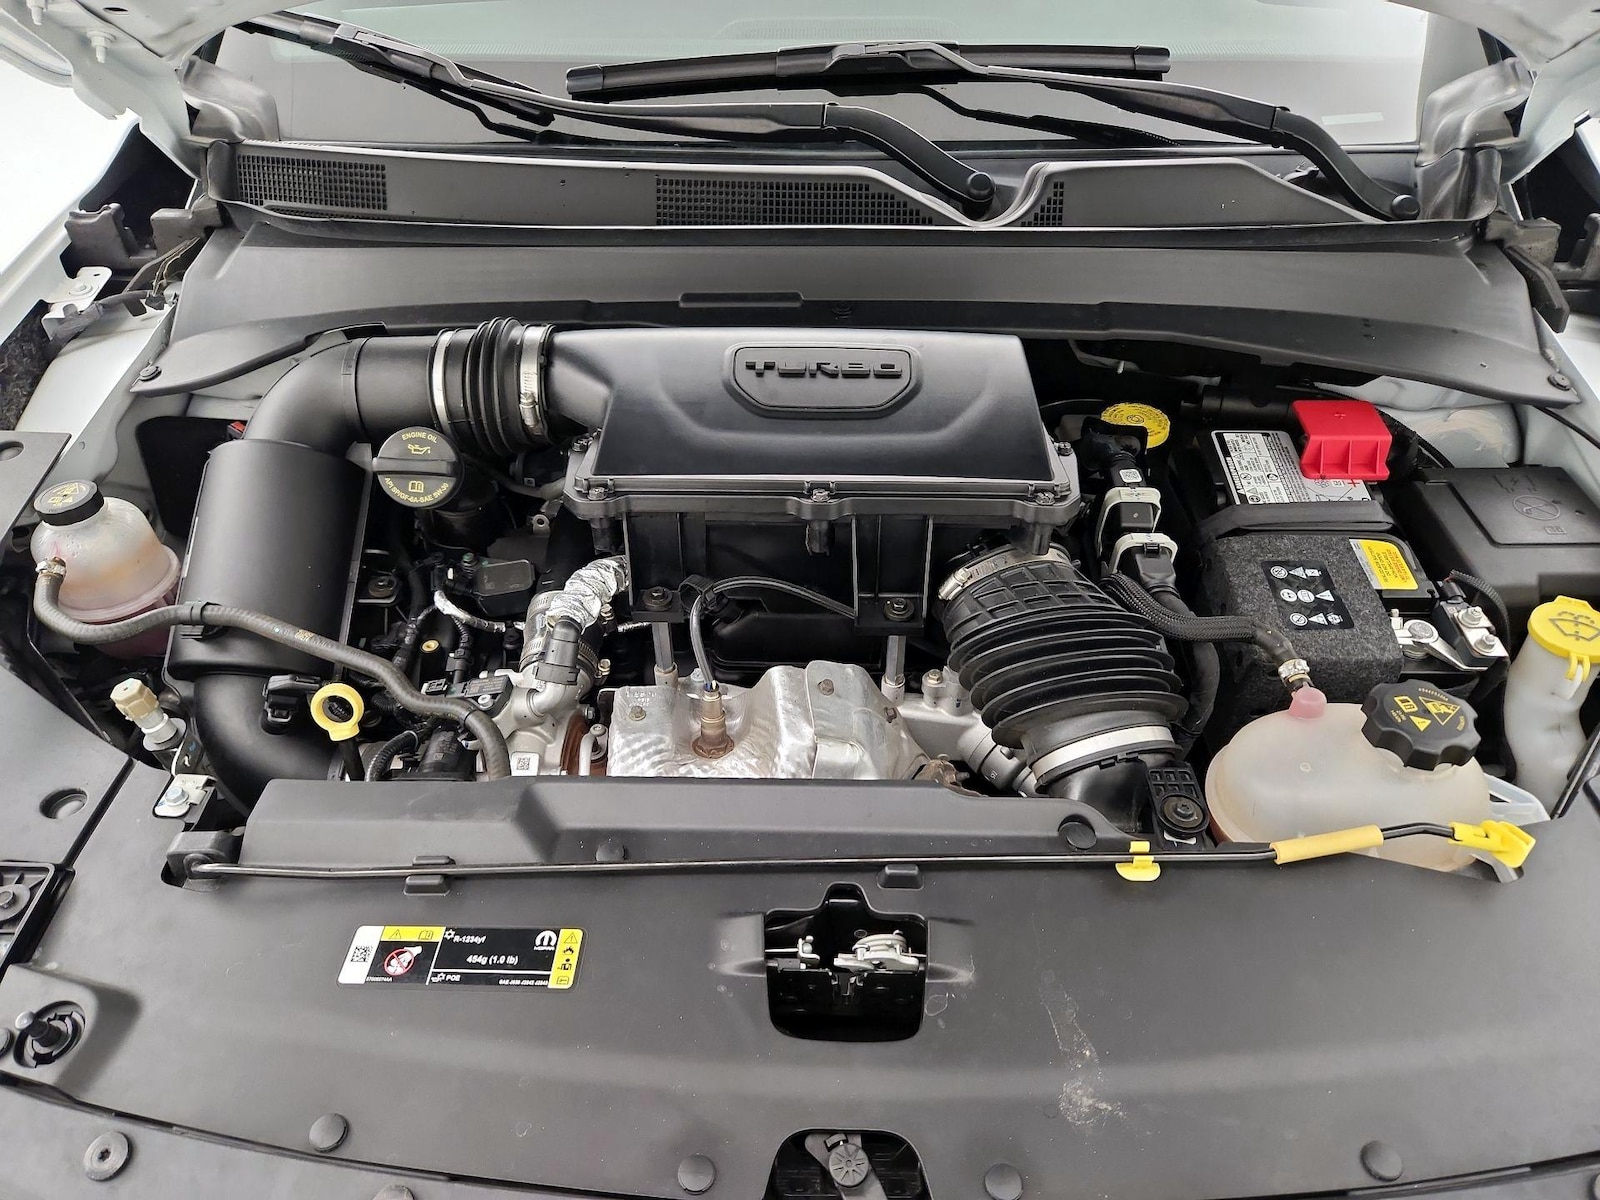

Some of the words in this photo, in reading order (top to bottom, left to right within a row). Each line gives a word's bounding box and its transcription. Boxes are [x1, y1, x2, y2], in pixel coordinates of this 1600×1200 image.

[745, 361, 903, 379] TURBO
[402, 431, 426, 440] ENGINE
[427, 434, 438, 443] OIL
[453, 934, 487, 945] R-1234yf
[466, 954, 488, 965] 454g
[488, 955, 506, 965] (1.0
[506, 955, 519, 965] lb)
[445, 974, 461, 982] POE
